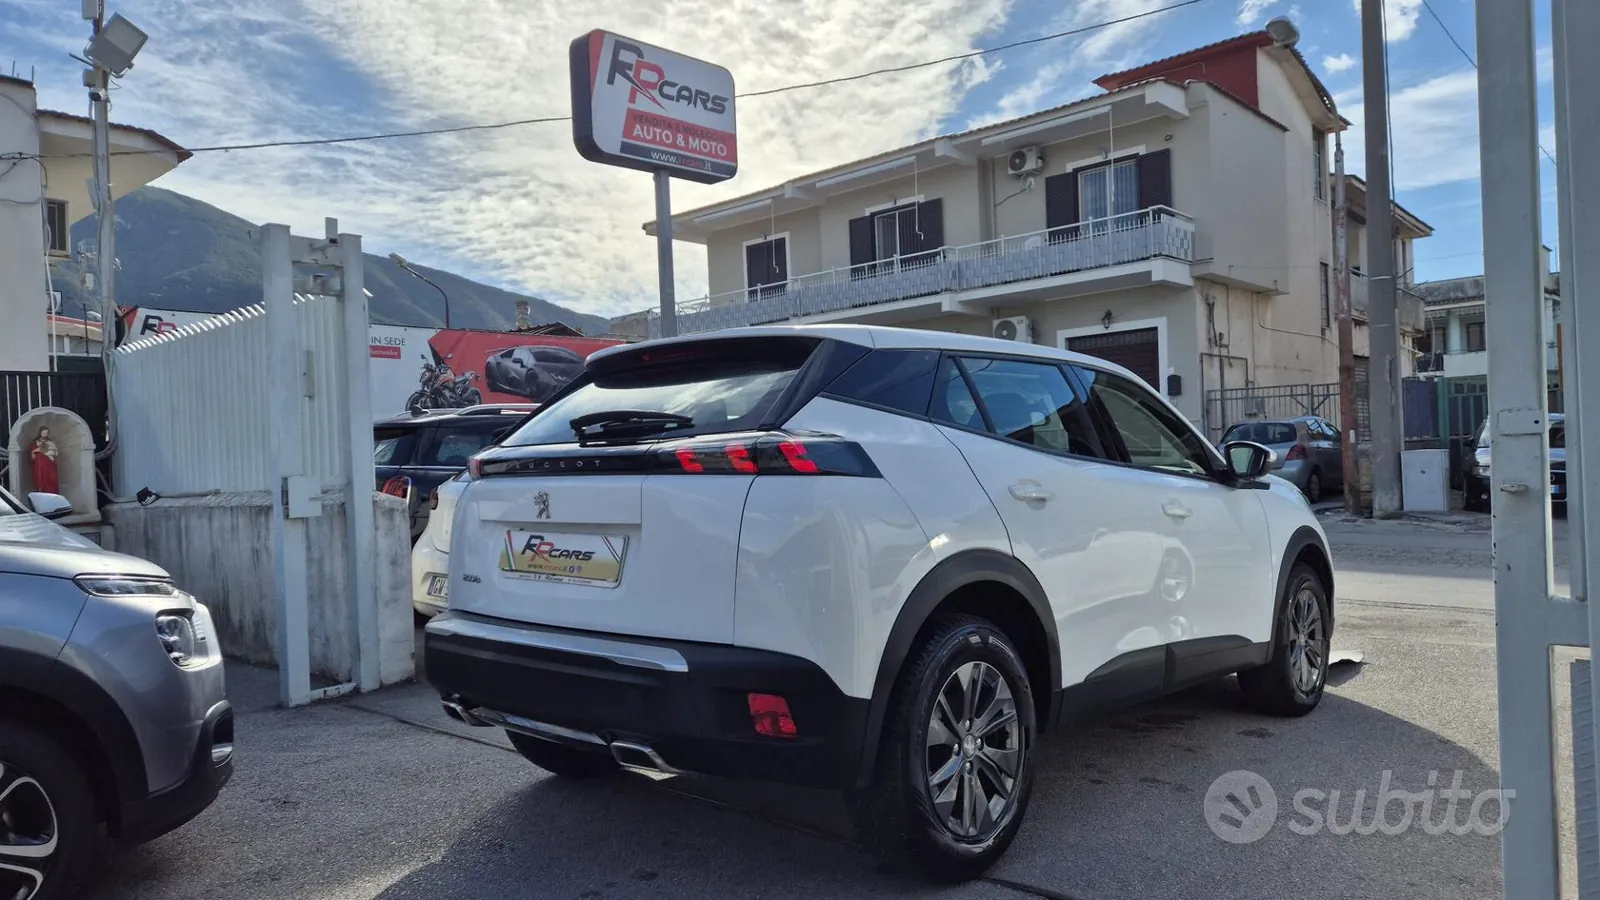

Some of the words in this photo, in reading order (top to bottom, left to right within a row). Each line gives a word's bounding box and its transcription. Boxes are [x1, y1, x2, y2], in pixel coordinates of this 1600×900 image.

[632, 114, 673, 131] VENDITA
[633, 124, 673, 144] AUTO
[676, 134, 686, 148] &
[688, 135, 727, 156] MOTO
[371, 336, 382, 345] IN
[384, 337, 406, 346] SEDE
